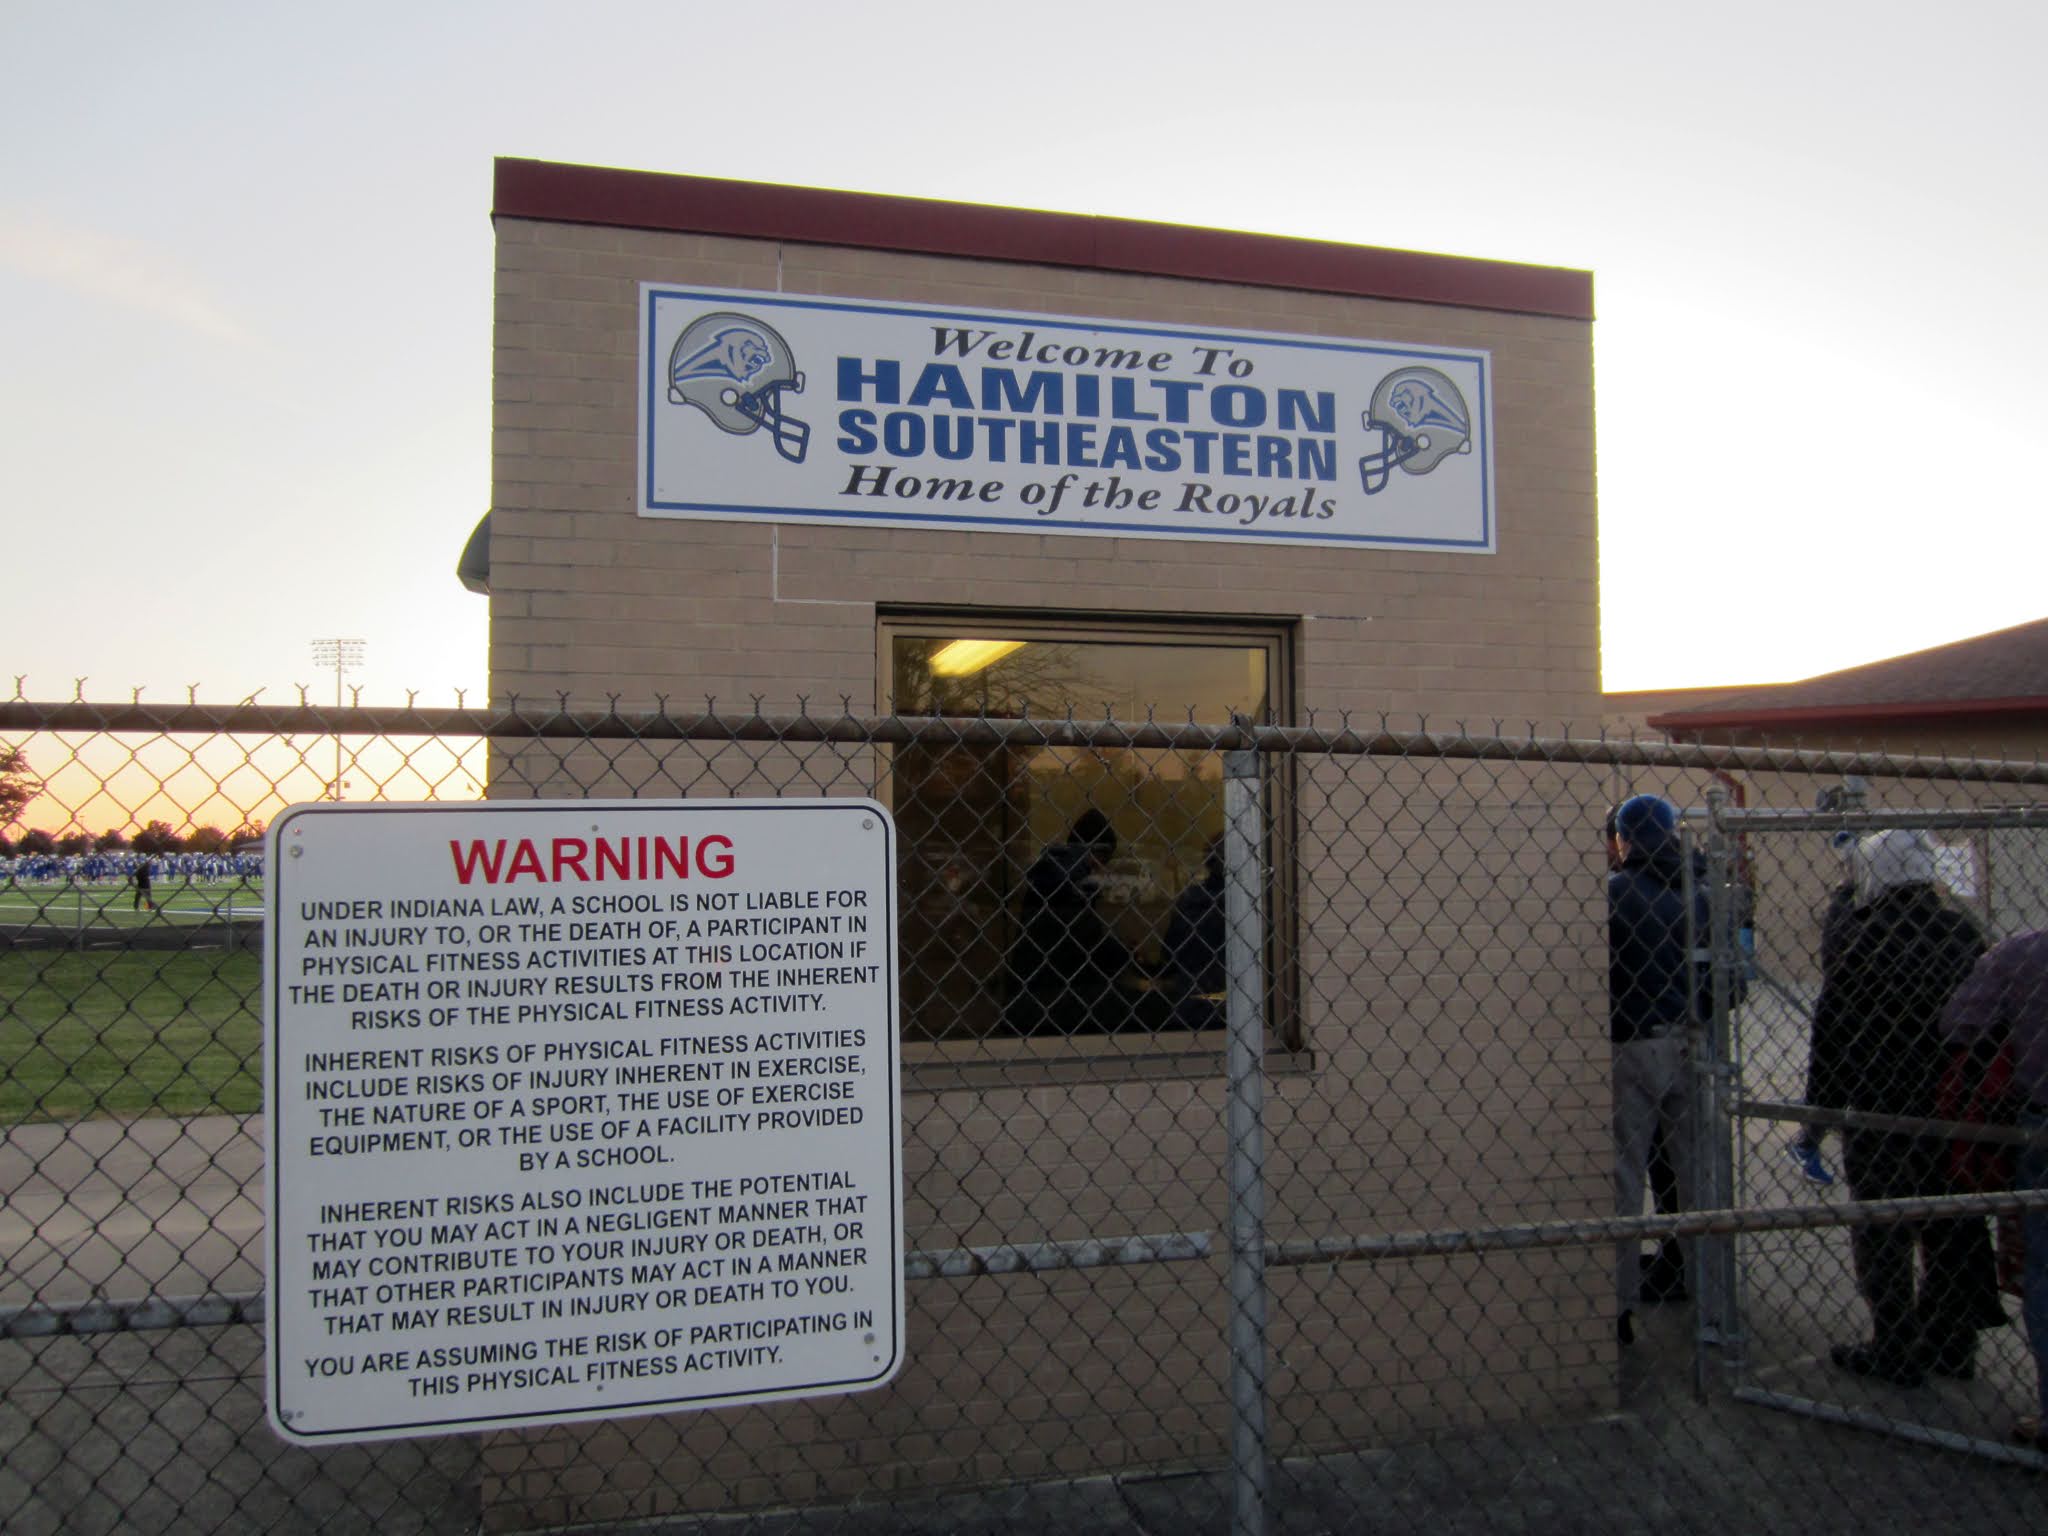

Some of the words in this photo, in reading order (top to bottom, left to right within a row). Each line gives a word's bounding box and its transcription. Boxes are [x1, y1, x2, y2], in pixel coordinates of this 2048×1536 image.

[931, 327, 1172, 373] Welcome
[1193, 346, 1254, 378] To
[837, 357, 1336, 433] HAMILTON
[837, 409, 1336, 480] SOUTHEASTERN
[838, 464, 1004, 502] Home
[1019, 474, 1078, 515] of
[1082, 477, 1161, 511] the
[1173, 483, 1337, 525] Royals
[449, 834, 735, 885] WARNING
[301, 900, 383, 921] UNDER
[390, 897, 485, 919] INDIANA
[490, 896, 544, 919] LAW,
[549, 896, 567, 916] A
[571, 894, 665, 915] SCHOOL
[669, 893, 690, 913] IS
[695, 892, 740, 912] NOT
[746, 890, 820, 911] LIABLE
[825, 889, 869, 909] FOR
[303, 929, 337, 949] AN
[345, 926, 429, 948] INJURY
[433, 925, 471, 948] TO,
[478, 924, 512, 944] OR
[517, 923, 563, 943] THE
[569, 920, 641, 942] DEATH
[647, 919, 681, 942] OF,
[685, 919, 703, 939] A
[707, 915, 843, 938] PARTICIPANT
[847, 915, 867, 933] IN
[302, 954, 420, 977] PHYSICAL
[426, 950, 521, 973] FITNESS
[525, 947, 647, 970] ACTIVITIES
[651, 946, 679, 966] AT
[684, 944, 733, 965] THIS
[739, 941, 844, 963] LOCATION
[850, 940, 868, 959] IF
[287, 983, 335, 1005] THE
[342, 981, 420, 1003] DEATH
[426, 980, 461, 1001] OR
[467, 976, 549, 999] INJURY
[554, 973, 654, 996] RESULTS
[661, 971, 723, 992] FROM
[728, 969, 771, 989] THE
[776, 965, 881, 987] INHERENT
[351, 1008, 422, 1031] RISKS
[428, 1007, 460, 1028] OF
[465, 1005, 511, 1026] THE
[517, 1001, 629, 1024] PHYSICAL
[635, 996, 725, 1019] FITNESS
[728, 993, 827, 1015] ACTIVITY.
[305, 1048, 425, 1073] INHERENT
[431, 1045, 500, 1067] RISKS
[506, 1043, 537, 1064] OF
[543, 1039, 655, 1063] PHYSICAL
[660, 1034, 749, 1057] FITNESS
[753, 1028, 866, 1053] ACTIVITIES
[305, 1076, 409, 1101] INCLUDE
[415, 1073, 485, 1096] RISKS
[491, 1071, 523, 1092] OF
[529, 1067, 609, 1090] INJURY
[615, 1061, 725, 1086] INHERENT
[731, 1060, 751, 1080] IN
[757, 1054, 866, 1079] EXERCISE,
[318, 1106, 366, 1128] THE
[372, 1101, 467, 1125] NATURE
[473, 1099, 505, 1120] OF
[509, 1098, 527, 1119] A
[531, 1093, 611, 1117] SPORT,
[616, 1091, 661, 1112] THE
[667, 1088, 710, 1110] USE
[716, 1087, 745, 1107] OF
[751, 1080, 855, 1105] EXERCISE
[309, 1129, 451, 1157] EQUIPMENT,
[457, 1127, 492, 1149] OR
[497, 1124, 543, 1146] THE
[549, 1121, 595, 1143] USE
[600, 1119, 631, 1141] OF
[635, 1119, 652, 1138] A
[657, 1112, 752, 1137] FACILITY
[757, 1106, 864, 1131] PROVIDED
[519, 1151, 550, 1172] BY
[554, 1150, 571, 1170] A
[576, 1144, 675, 1169] SCHOOL.
[321, 1197, 440, 1225] INHERENT
[446, 1193, 515, 1217] RISKS
[520, 1188, 583, 1212] ALSO
[588, 1181, 685, 1207] INCLUDE
[690, 1178, 733, 1200] THE
[739, 1170, 857, 1197] POTENTIAL
[306, 1229, 368, 1253] THAT
[373, 1226, 423, 1249] YOU
[430, 1222, 479, 1245] MAY
[483, 1219, 531, 1241] ACT
[537, 1217, 558, 1238] IN
[563, 1216, 581, 1236] A
[586, 1206, 713, 1234] NEGLIGENT
[718, 1199, 810, 1225] MANNER
[815, 1195, 869, 1217] THAT
[312, 1257, 362, 1281] MAY
[368, 1247, 519, 1277] CONTRIBUTE
[524, 1245, 555, 1265] TO
[561, 1239, 625, 1263] YOUR
[631, 1233, 709, 1258] INJURY
[714, 1230, 747, 1252] OR
[752, 1224, 827, 1249] DEATH,
[833, 1221, 864, 1242] OR
[307, 1285, 369, 1309] THAT
[375, 1279, 457, 1305] OTHER
[463, 1266, 625, 1298] PARTICIPANTS
[631, 1262, 677, 1285] MAY
[681, 1258, 726, 1281] ACT
[731, 1256, 752, 1277] IN
[757, 1255, 773, 1275] A
[777, 1247, 868, 1273] MANNER
[323, 1312, 385, 1336] THAT
[391, 1308, 440, 1331] MAY
[446, 1301, 536, 1327] RESULT
[541, 1298, 563, 1319] IN
[570, 1291, 650, 1317] INJURY
[655, 1288, 688, 1309] OR
[693, 1281, 765, 1307] DEATH
[770, 1279, 799, 1299] TO
[804, 1274, 854, 1296] YOU.
[304, 1355, 355, 1379] YOU
[360, 1350, 410, 1374] ARE
[415, 1340, 538, 1370] ASSUMING
[544, 1335, 589, 1359] THE
[595, 1330, 648, 1355] RISK
[653, 1327, 684, 1349] OF
[689, 1312, 847, 1345] PARTICIPATING
[853, 1309, 873, 1329] IN
[407, 1374, 460, 1398] THIS
[467, 1365, 581, 1393] PHYSICAL
[586, 1355, 679, 1383] FITNESS
[683, 1344, 783, 1374] ACTIVITY.
